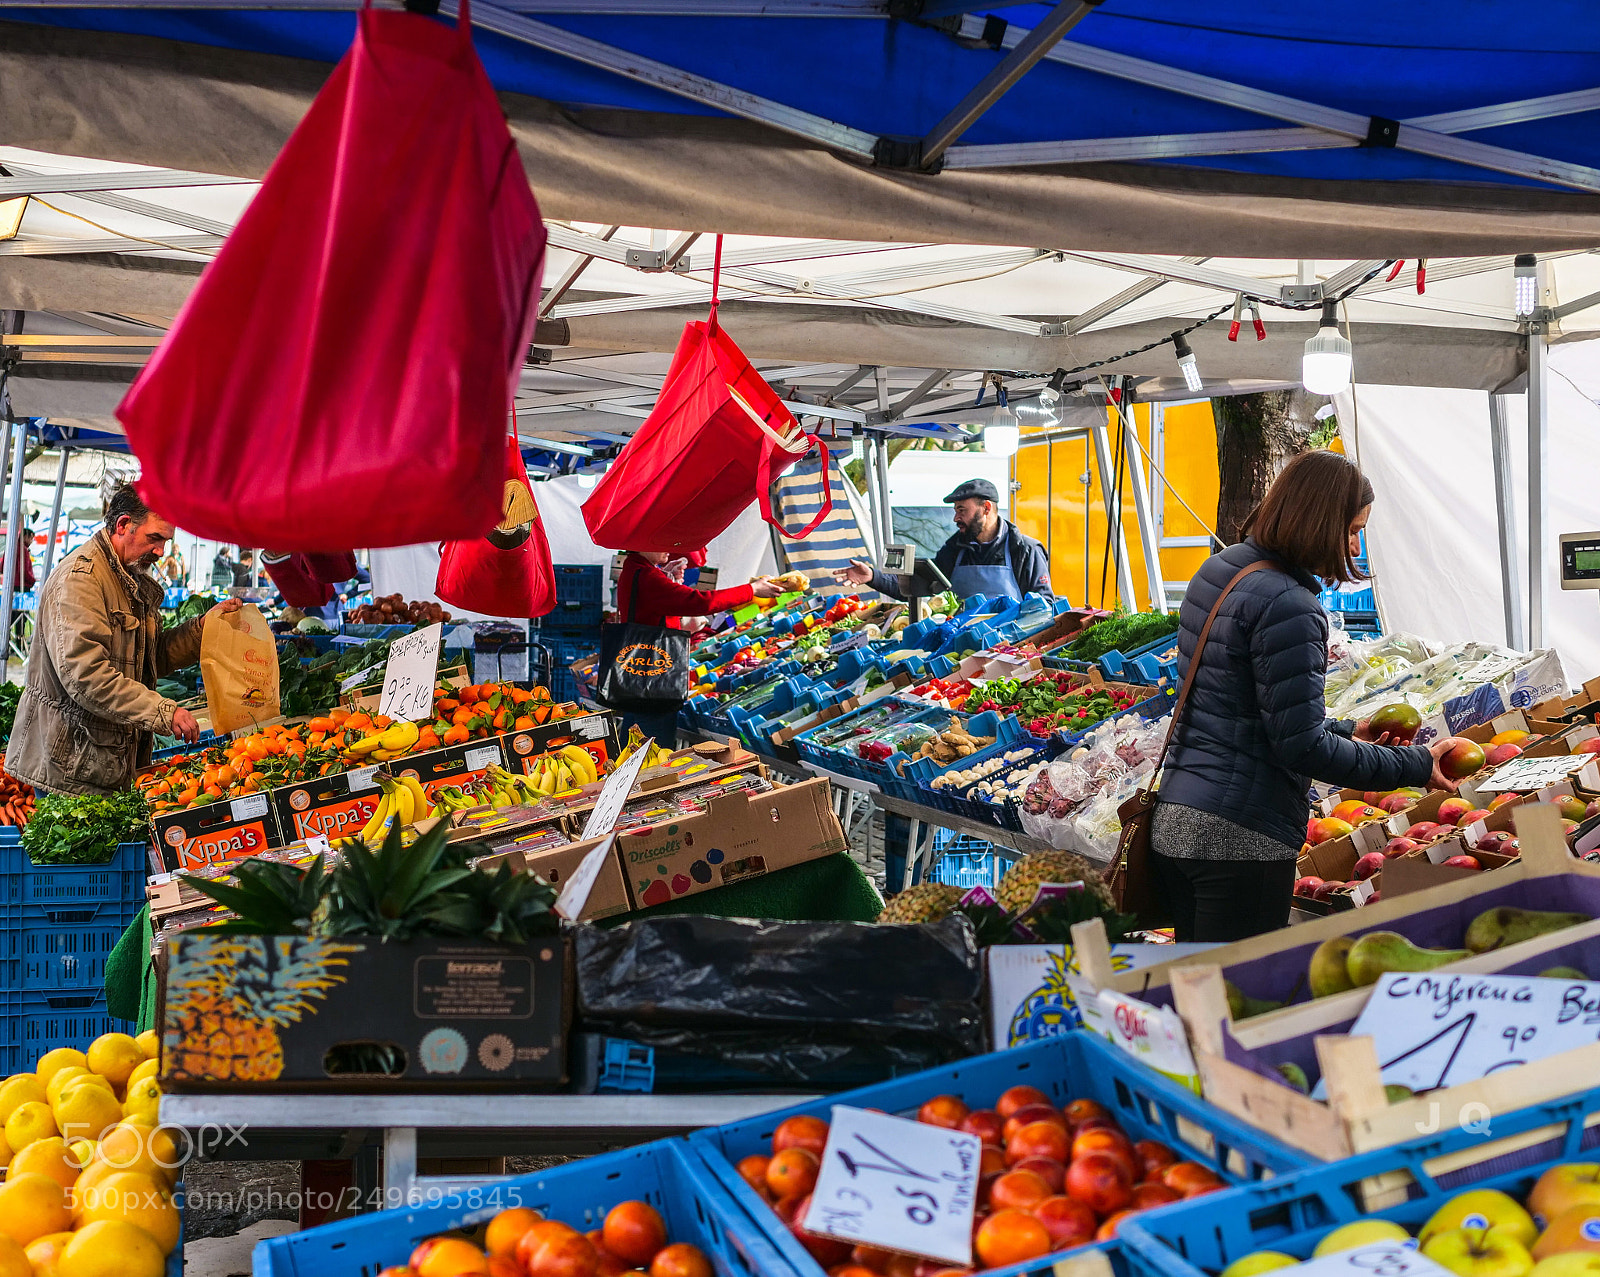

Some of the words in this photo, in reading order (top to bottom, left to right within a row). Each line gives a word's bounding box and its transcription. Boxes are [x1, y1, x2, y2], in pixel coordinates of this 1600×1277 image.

[615, 655, 673, 668] CARLOS
[1450, 707, 1476, 723] FRESH
[295, 801, 374, 839] Kippa's
[179, 827, 258, 867] Kippa's
[628, 839, 682, 863] Driscoll's
[1502, 1026, 1537, 1051] 90
